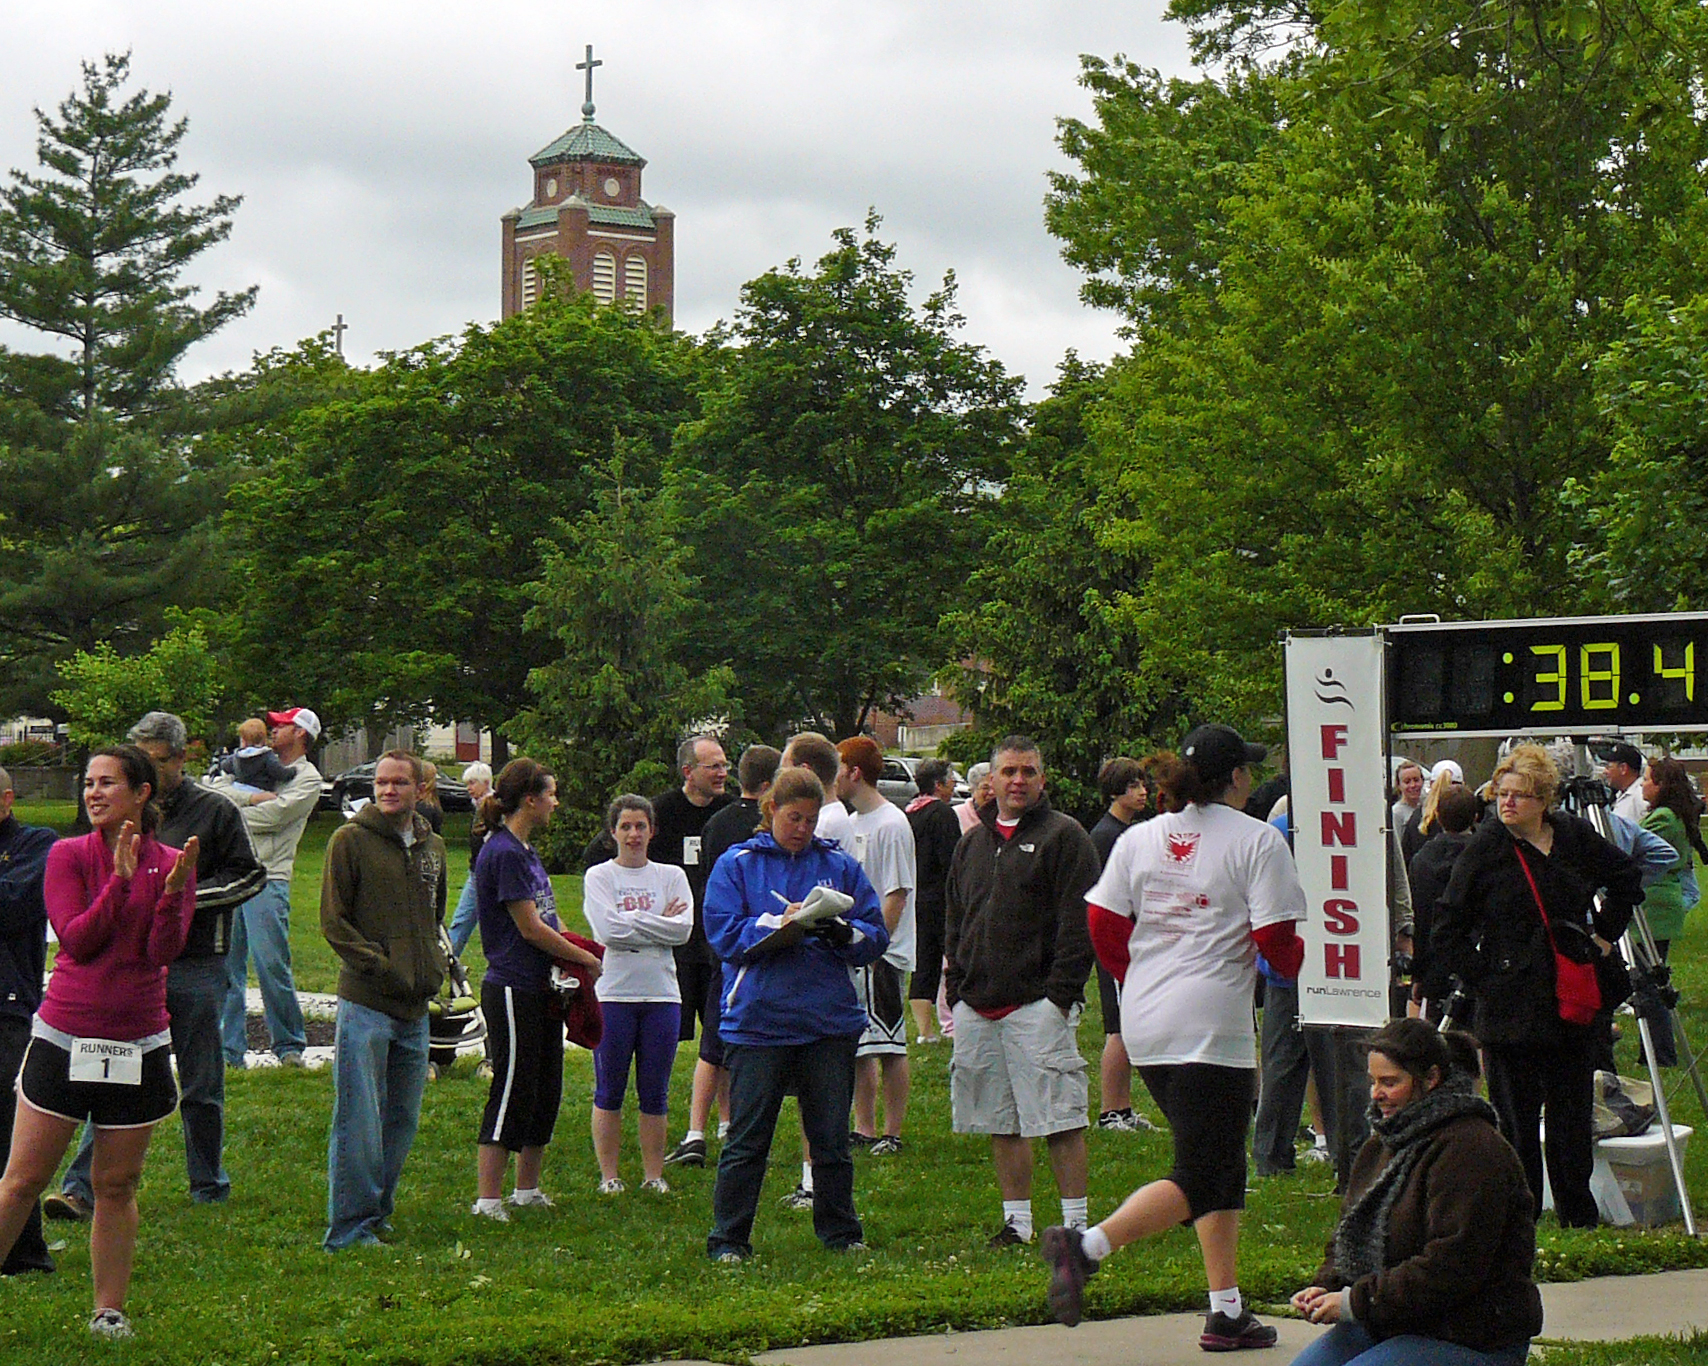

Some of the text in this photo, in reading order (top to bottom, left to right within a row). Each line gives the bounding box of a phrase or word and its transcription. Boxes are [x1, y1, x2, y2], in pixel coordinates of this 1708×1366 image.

[1320, 724, 1361, 981] FINISH
[1306, 986, 1382, 998] runLawrence
[80, 1043, 133, 1057] RUNNERS
[101, 1057, 110, 1078] 1
